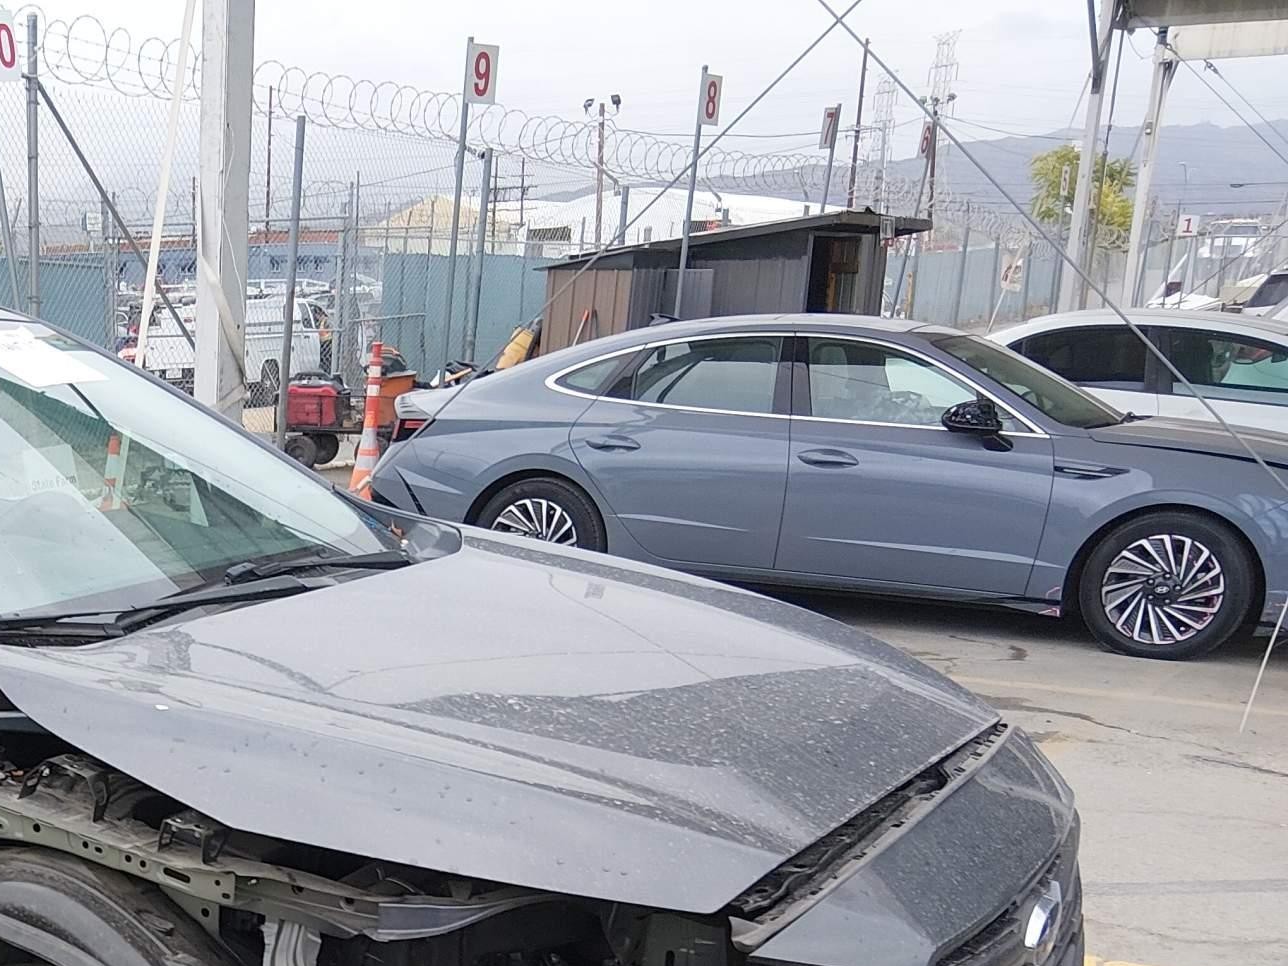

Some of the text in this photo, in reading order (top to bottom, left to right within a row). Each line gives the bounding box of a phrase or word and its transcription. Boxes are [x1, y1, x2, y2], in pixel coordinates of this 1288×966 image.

[474, 51, 491, 97] 9
[705, 80, 717, 120] 8
[824, 111, 835, 145] 7
[921, 125, 931, 154] 6
[1182, 217, 1193, 234] 1
